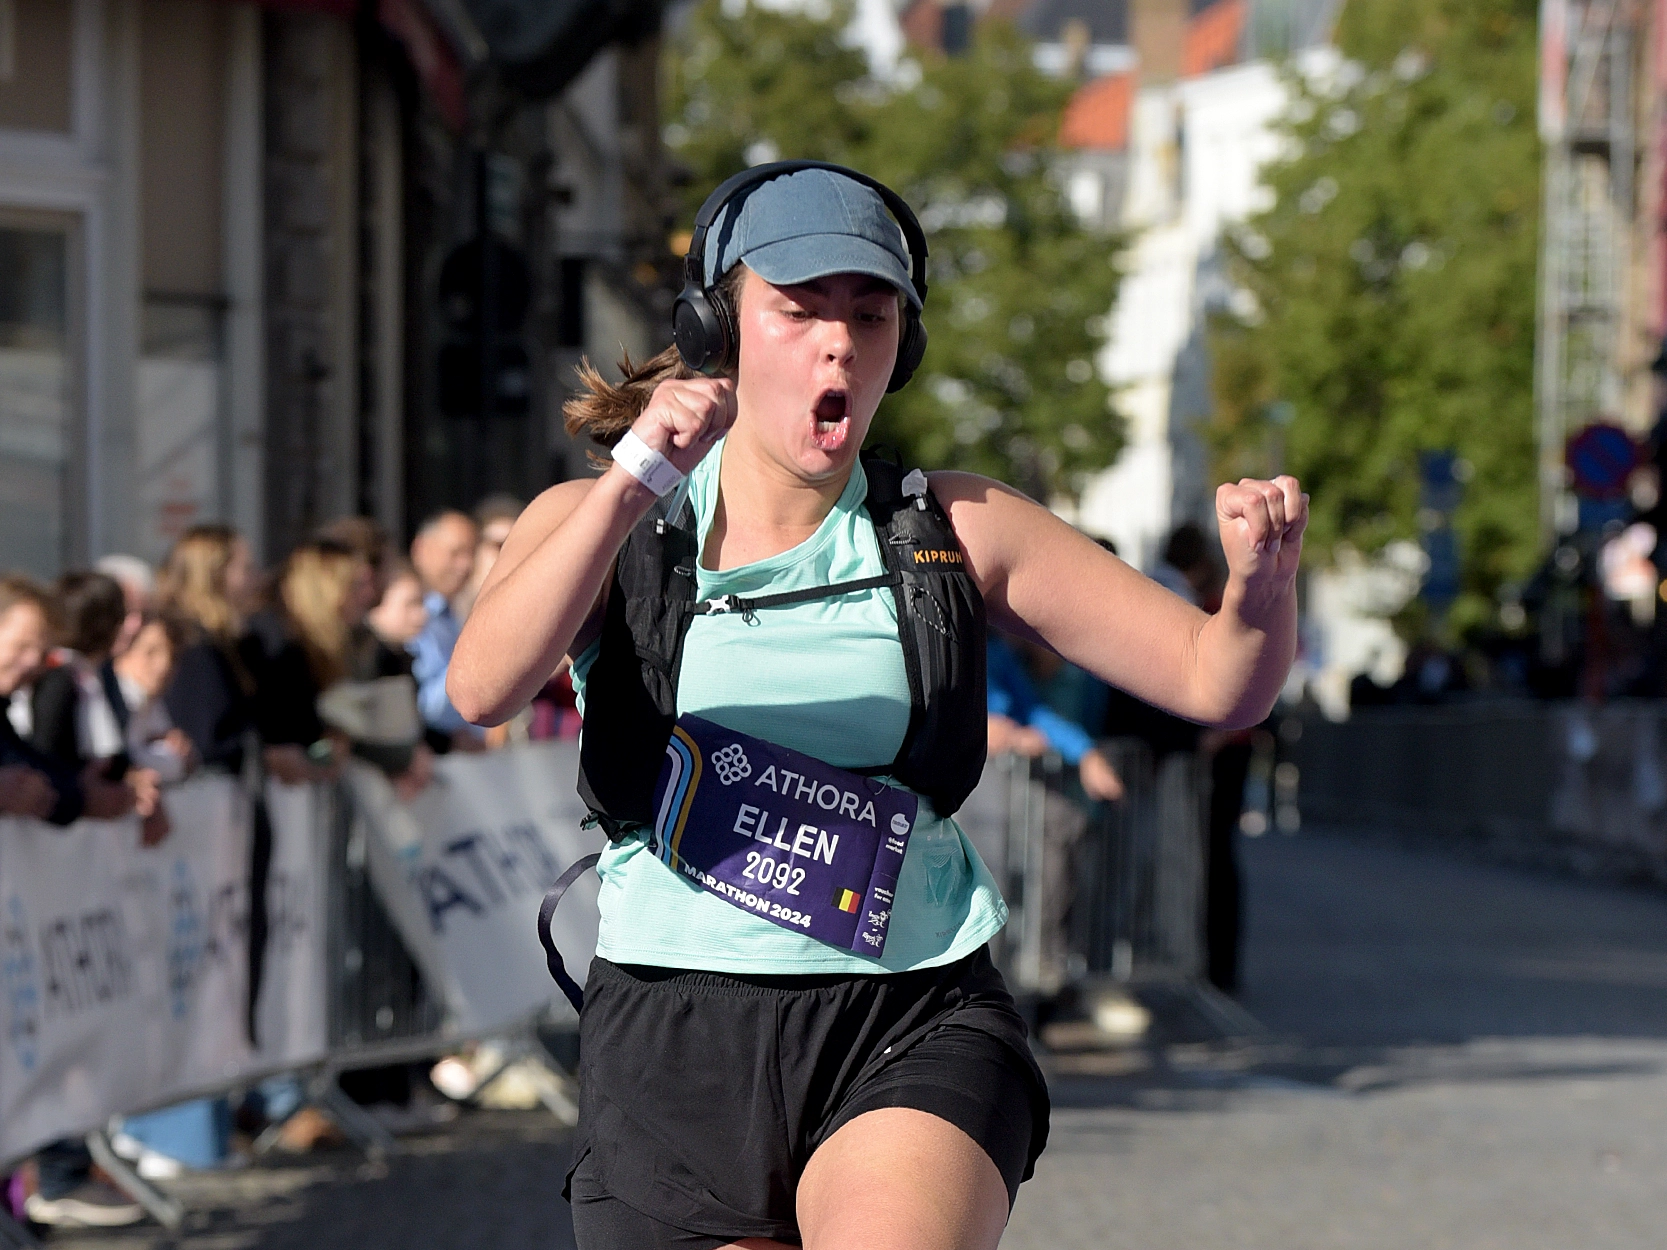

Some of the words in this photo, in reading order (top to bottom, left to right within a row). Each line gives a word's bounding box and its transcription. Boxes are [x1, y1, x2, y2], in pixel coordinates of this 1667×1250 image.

[914, 549, 963, 564] KIPRUN
[754, 765, 876, 828] ATHORA
[733, 803, 840, 865] ELLEN
[684, 863, 771, 914] MARATHON
[769, 903, 812, 928] 2024
[742, 851, 806, 896] 2092
